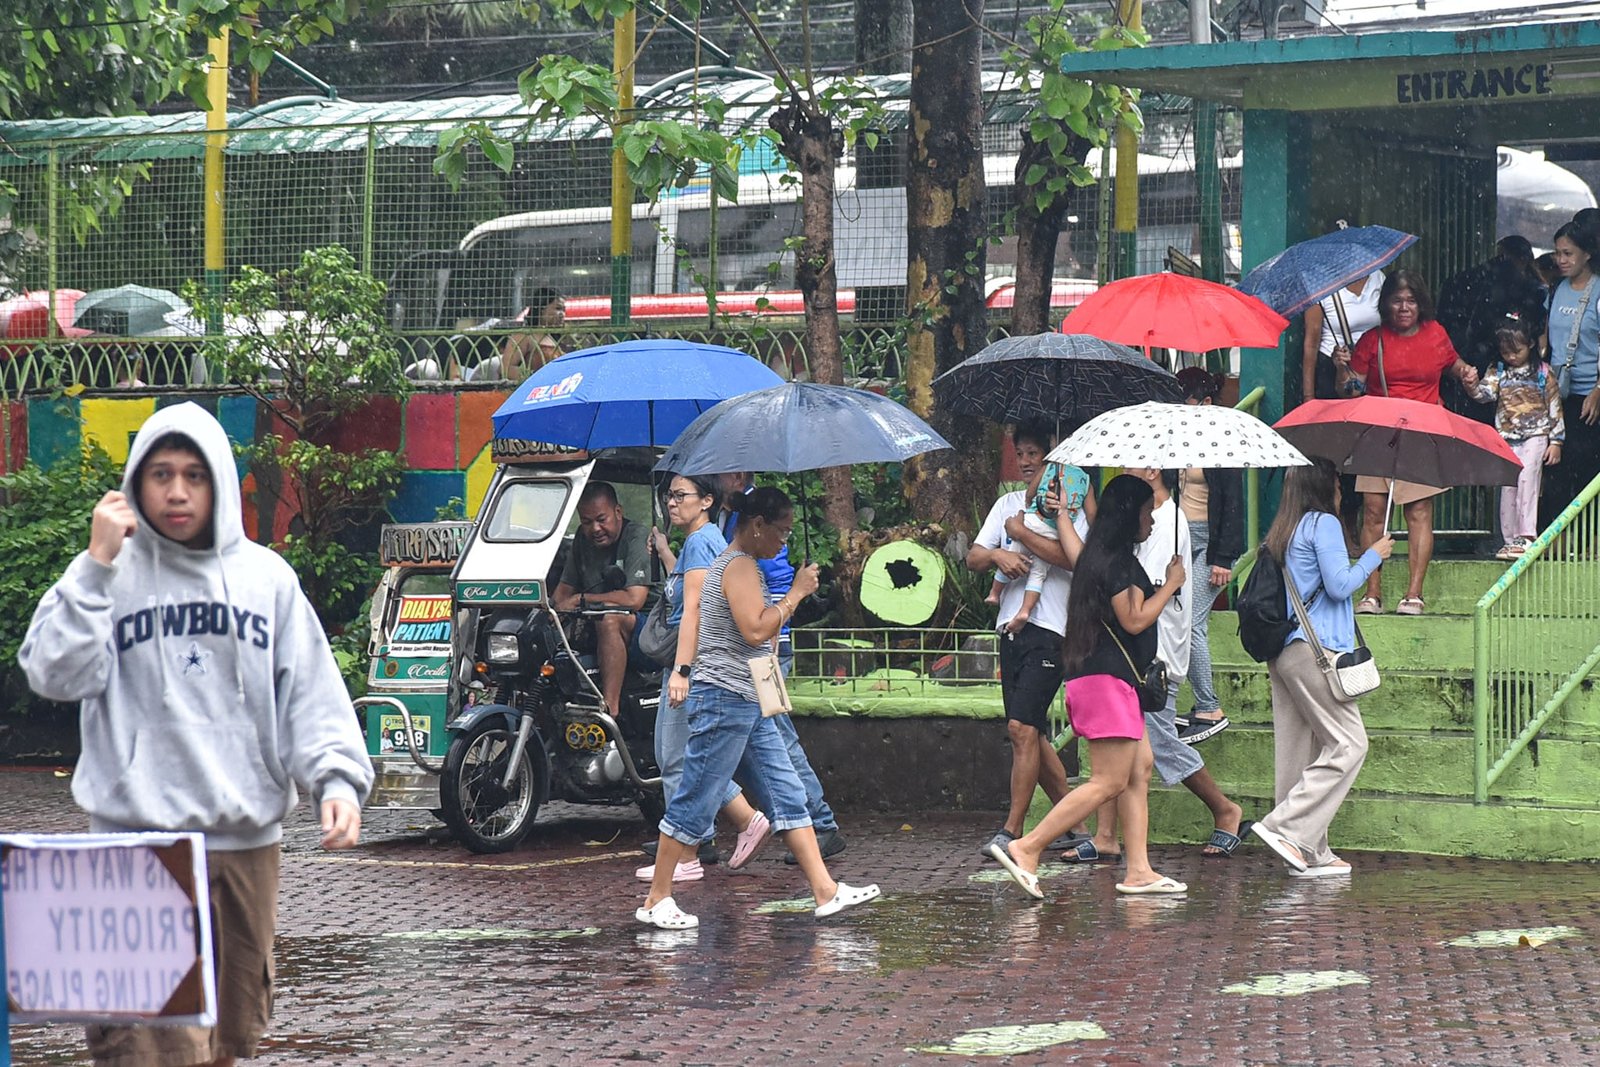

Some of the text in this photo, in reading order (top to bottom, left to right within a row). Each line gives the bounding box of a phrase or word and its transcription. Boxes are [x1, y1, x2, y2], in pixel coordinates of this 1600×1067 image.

[1397, 63, 1553, 104] ENTRANCE
[117, 601, 269, 652] COWBOYS
[393, 622, 451, 641] PATIENT
